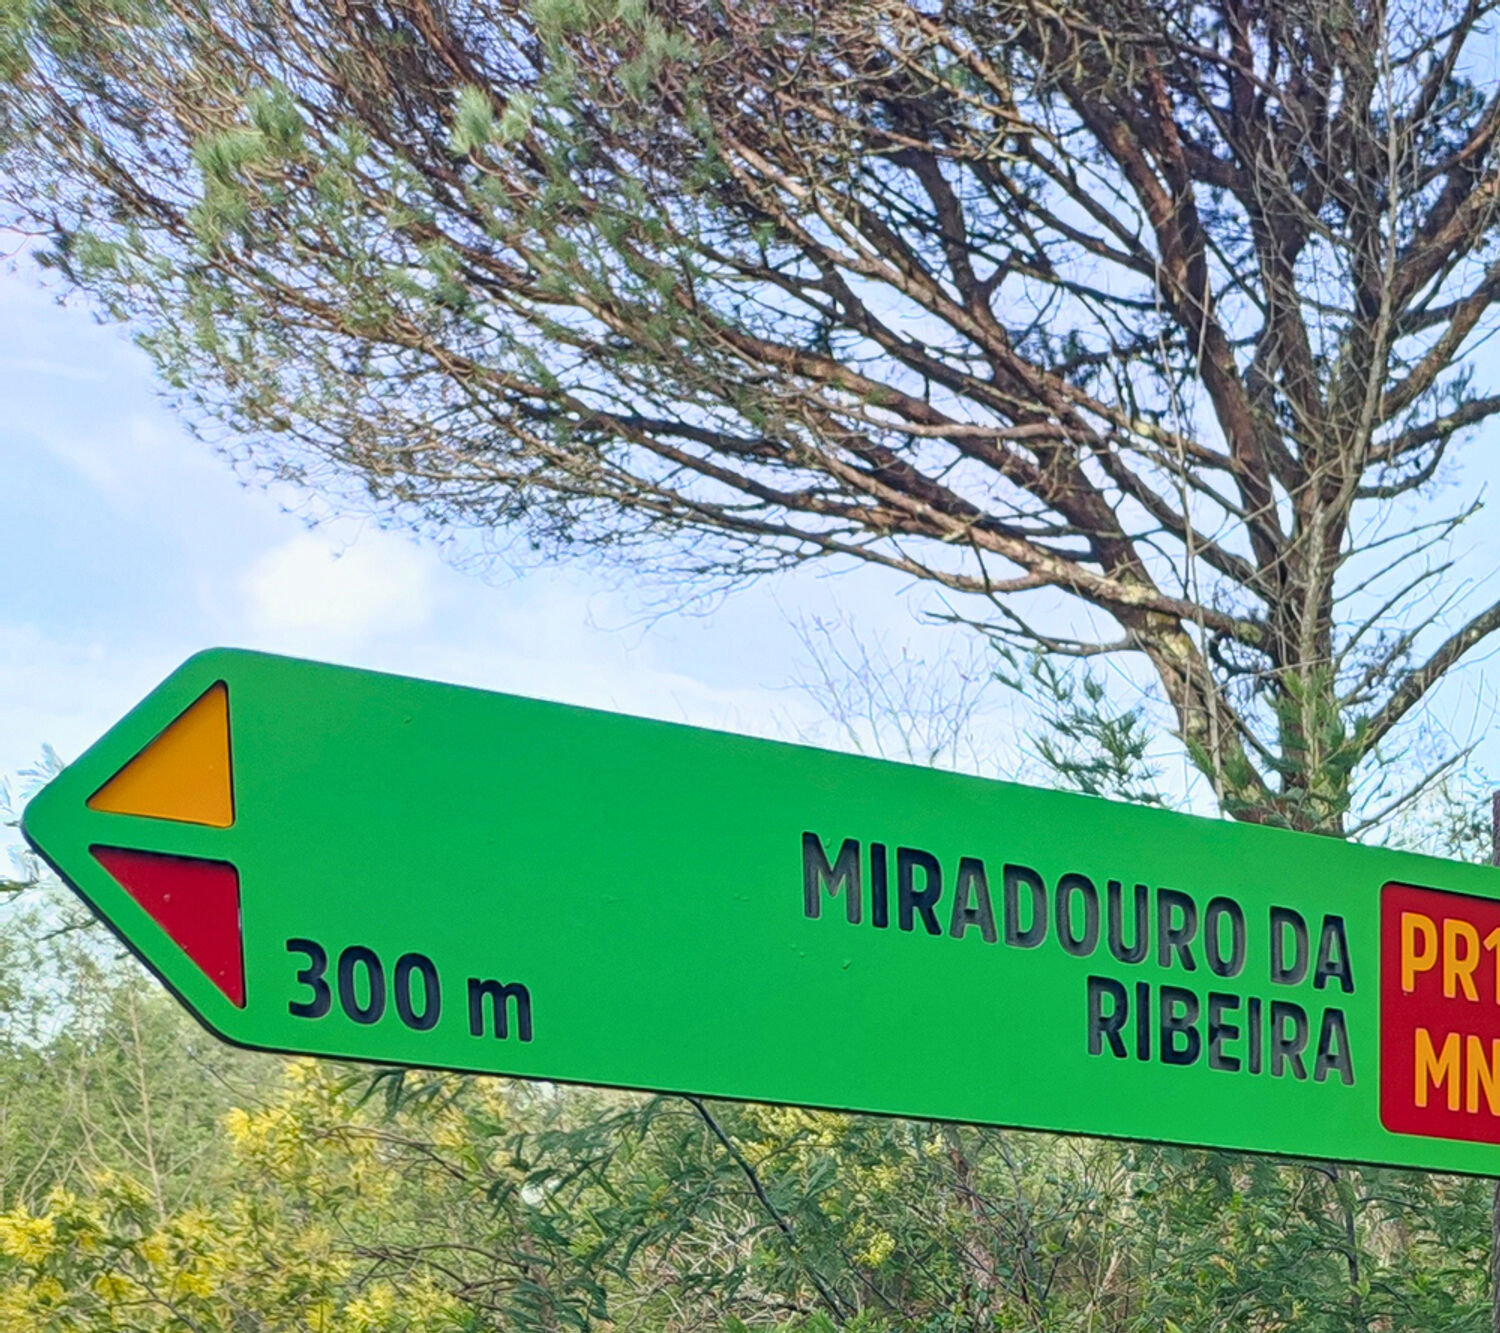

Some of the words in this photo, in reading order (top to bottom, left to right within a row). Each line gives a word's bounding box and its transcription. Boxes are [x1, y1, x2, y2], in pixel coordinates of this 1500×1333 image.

[801, 831, 1247, 978] MIRADOURO
[1269, 906, 1355, 994] DA
[285, 937, 442, 1031] 300
[467, 976, 533, 1042] m
[1087, 975, 1355, 1085] RIBEIRA
